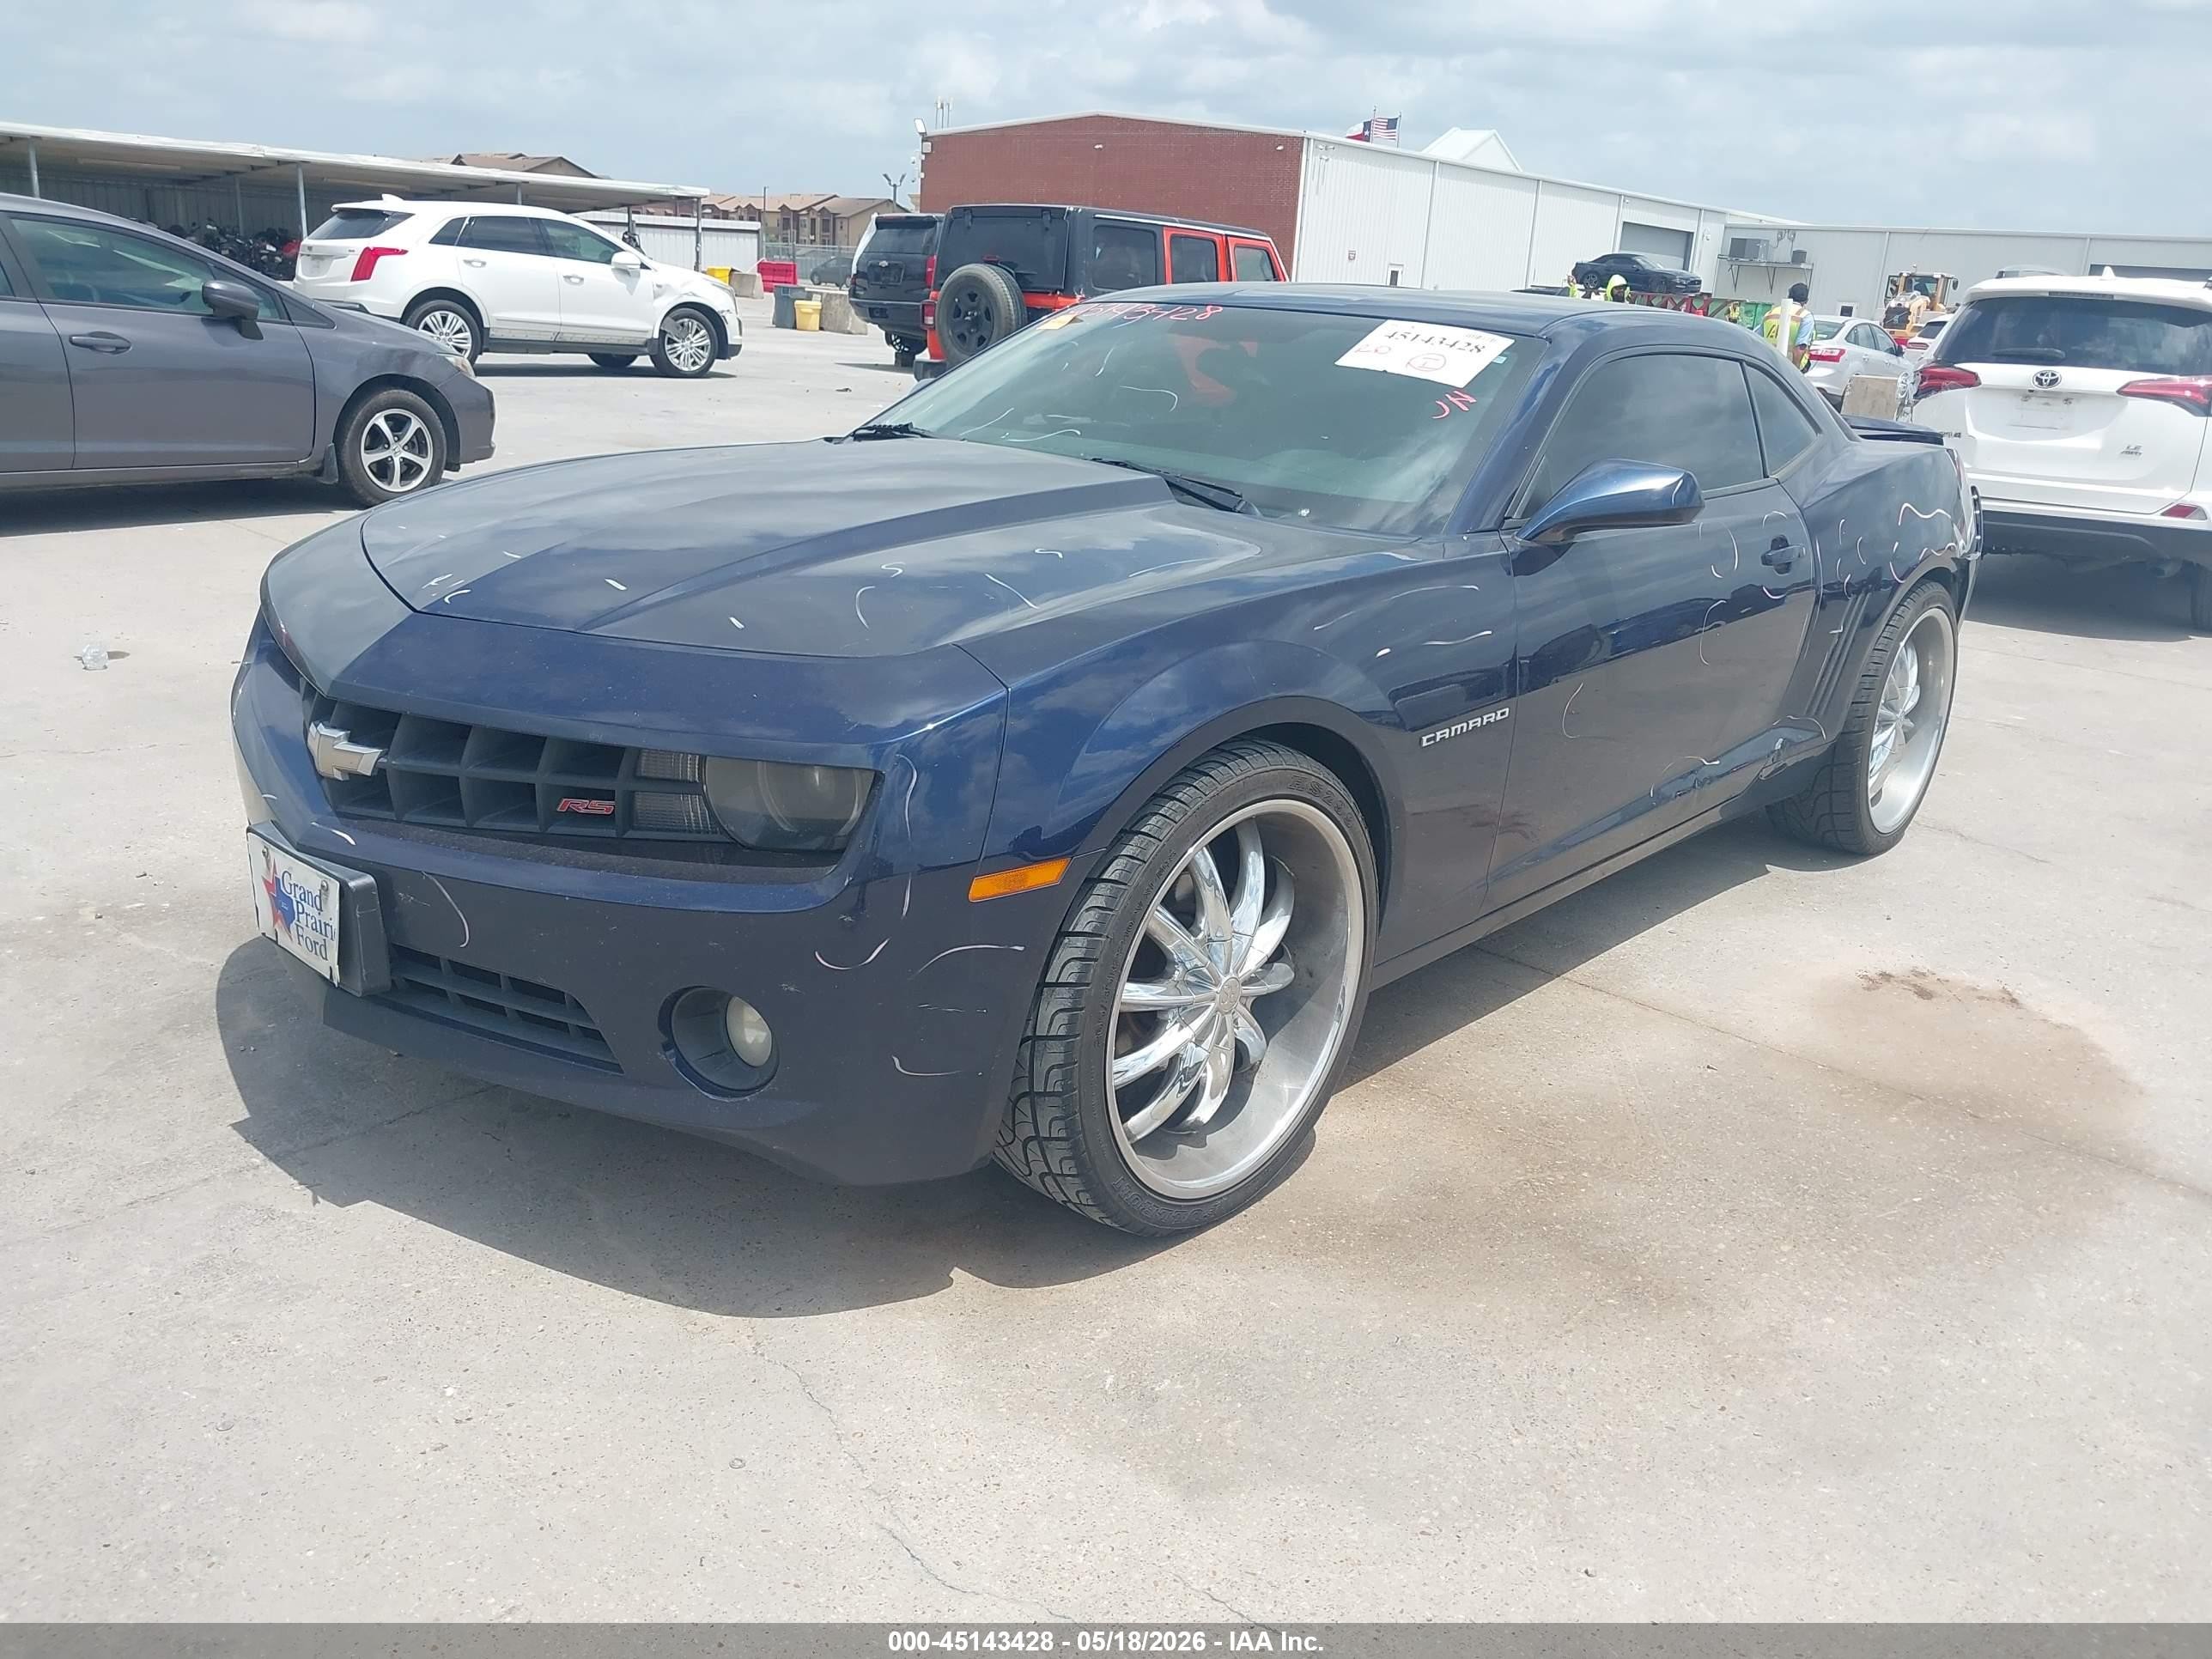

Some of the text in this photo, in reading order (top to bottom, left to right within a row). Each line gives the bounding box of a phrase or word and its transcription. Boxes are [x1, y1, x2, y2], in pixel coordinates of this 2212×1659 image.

[1385, 331, 1487, 354] 45143428
[1420, 707, 1510, 748] CAMARO
[556, 798, 616, 815] RS
[281, 870, 324, 913] Grand
[295, 921, 329, 961] Ford
